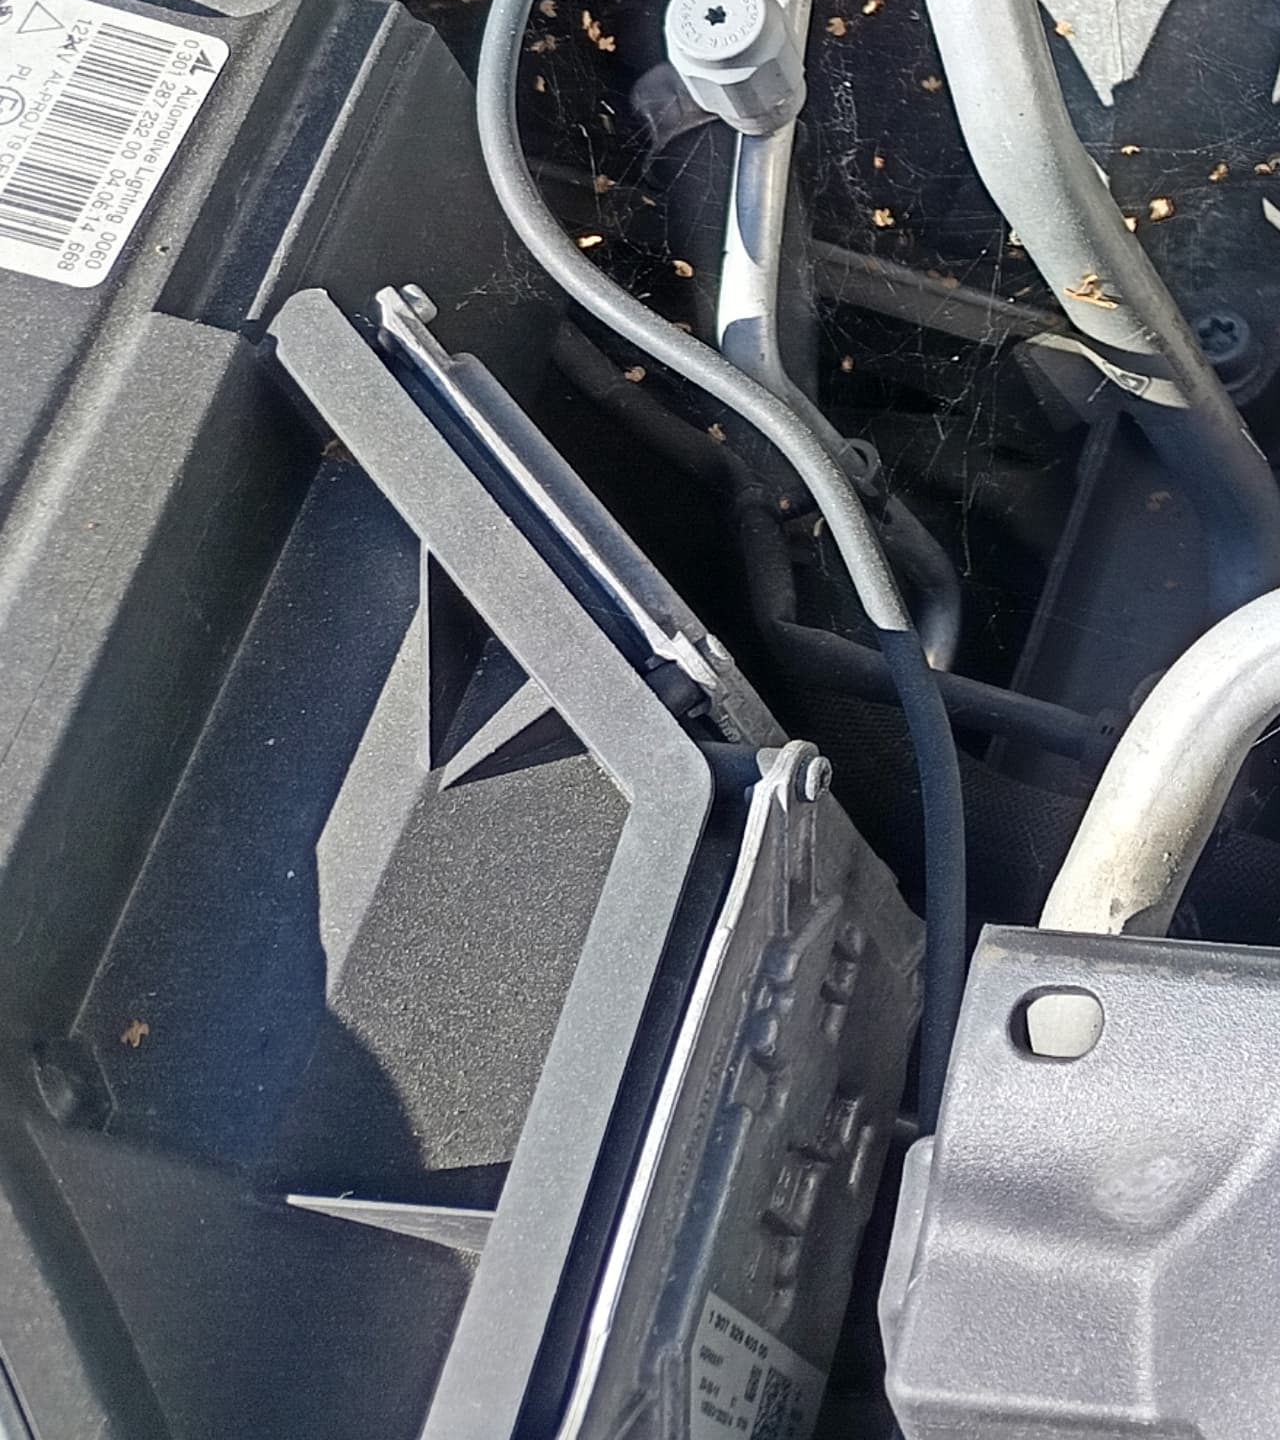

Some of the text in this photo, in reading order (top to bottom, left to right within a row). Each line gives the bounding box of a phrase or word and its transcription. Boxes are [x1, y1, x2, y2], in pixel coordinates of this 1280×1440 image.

[18, 69, 64, 131] AL-PROJ
[144, 85, 199, 164] Automotive
[57, 39, 200, 271] 0 301 287 232 00 04.06.14 668
[106, 166, 154, 224] Lighting
[85, 232, 117, 270] 0060
